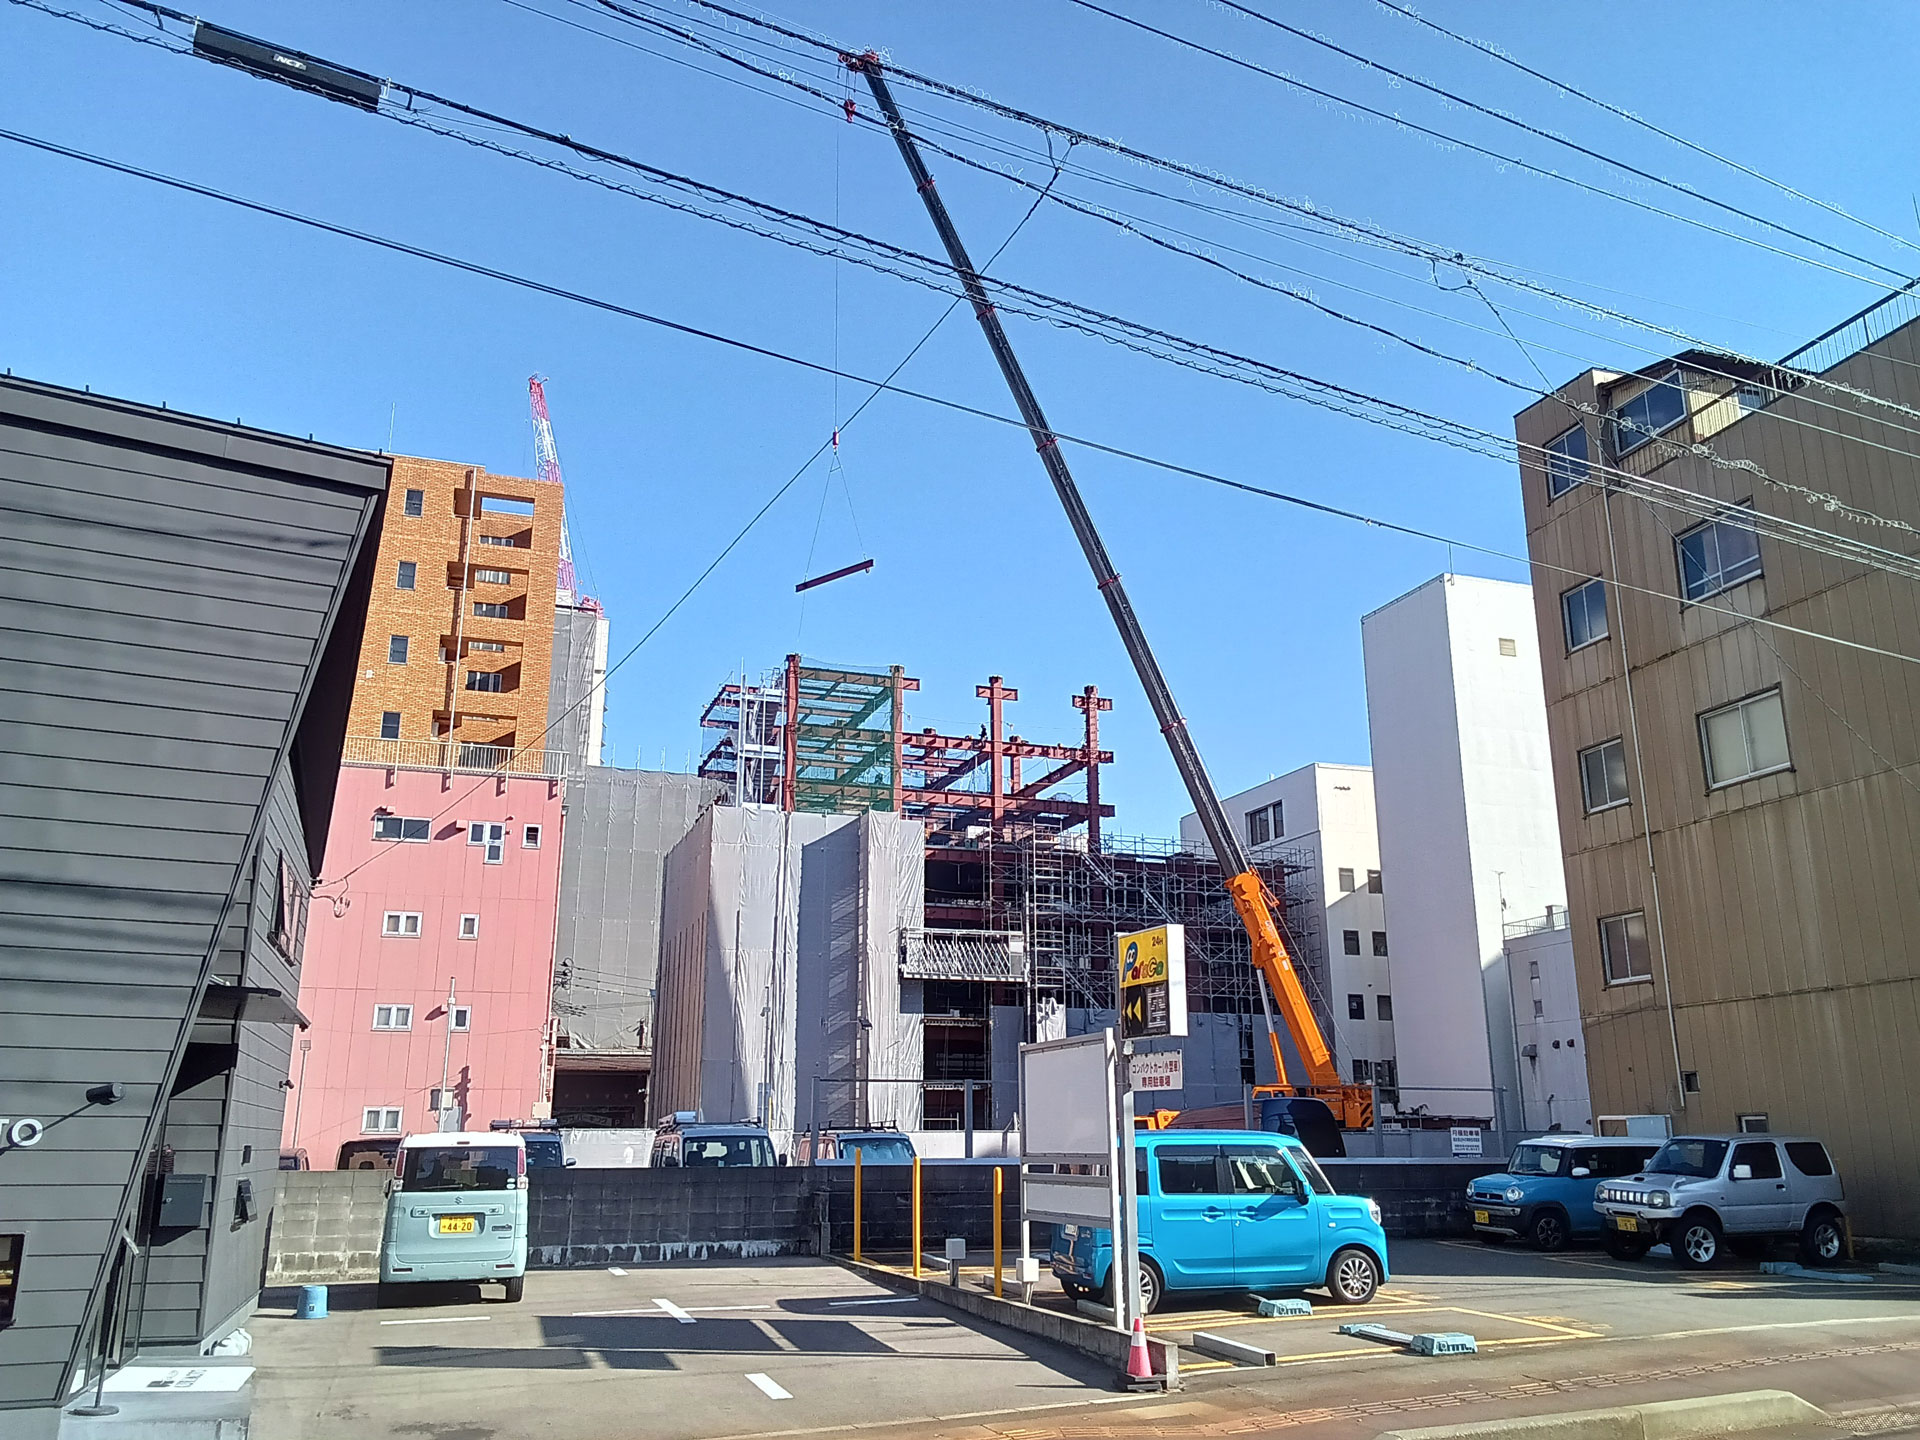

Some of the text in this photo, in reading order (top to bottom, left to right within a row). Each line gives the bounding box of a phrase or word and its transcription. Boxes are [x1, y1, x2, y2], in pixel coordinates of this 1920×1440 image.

[275, 54, 304, 69] NCT
[1152, 936, 1164, 947] 24H
[447, 1221, 473, 1232] 44-20
